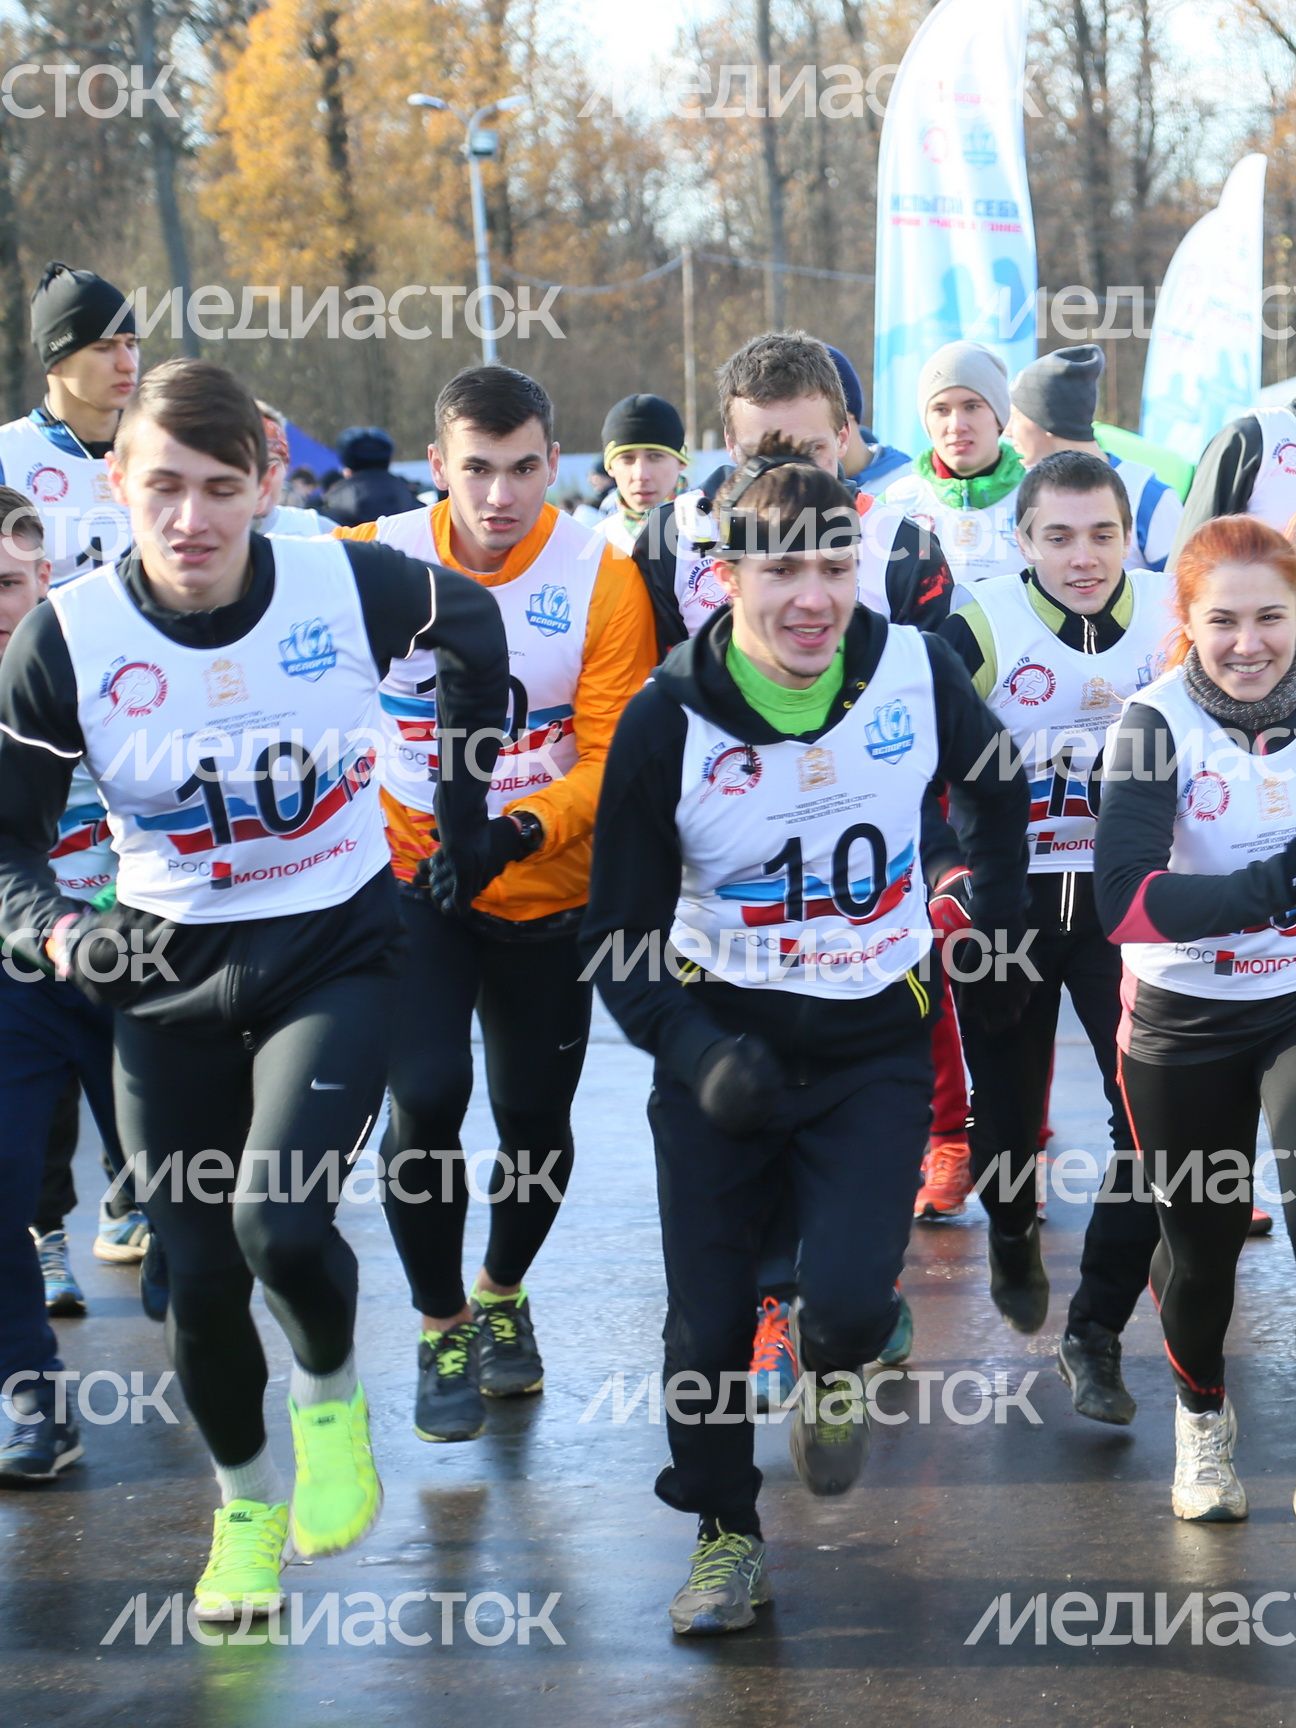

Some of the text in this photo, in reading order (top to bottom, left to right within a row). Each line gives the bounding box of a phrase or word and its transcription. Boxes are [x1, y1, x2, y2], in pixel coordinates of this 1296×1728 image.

[175, 741, 317, 845] 10
[234, 838, 358, 885] МОЛОДЕЖЬ
[763, 822, 888, 922] 10
